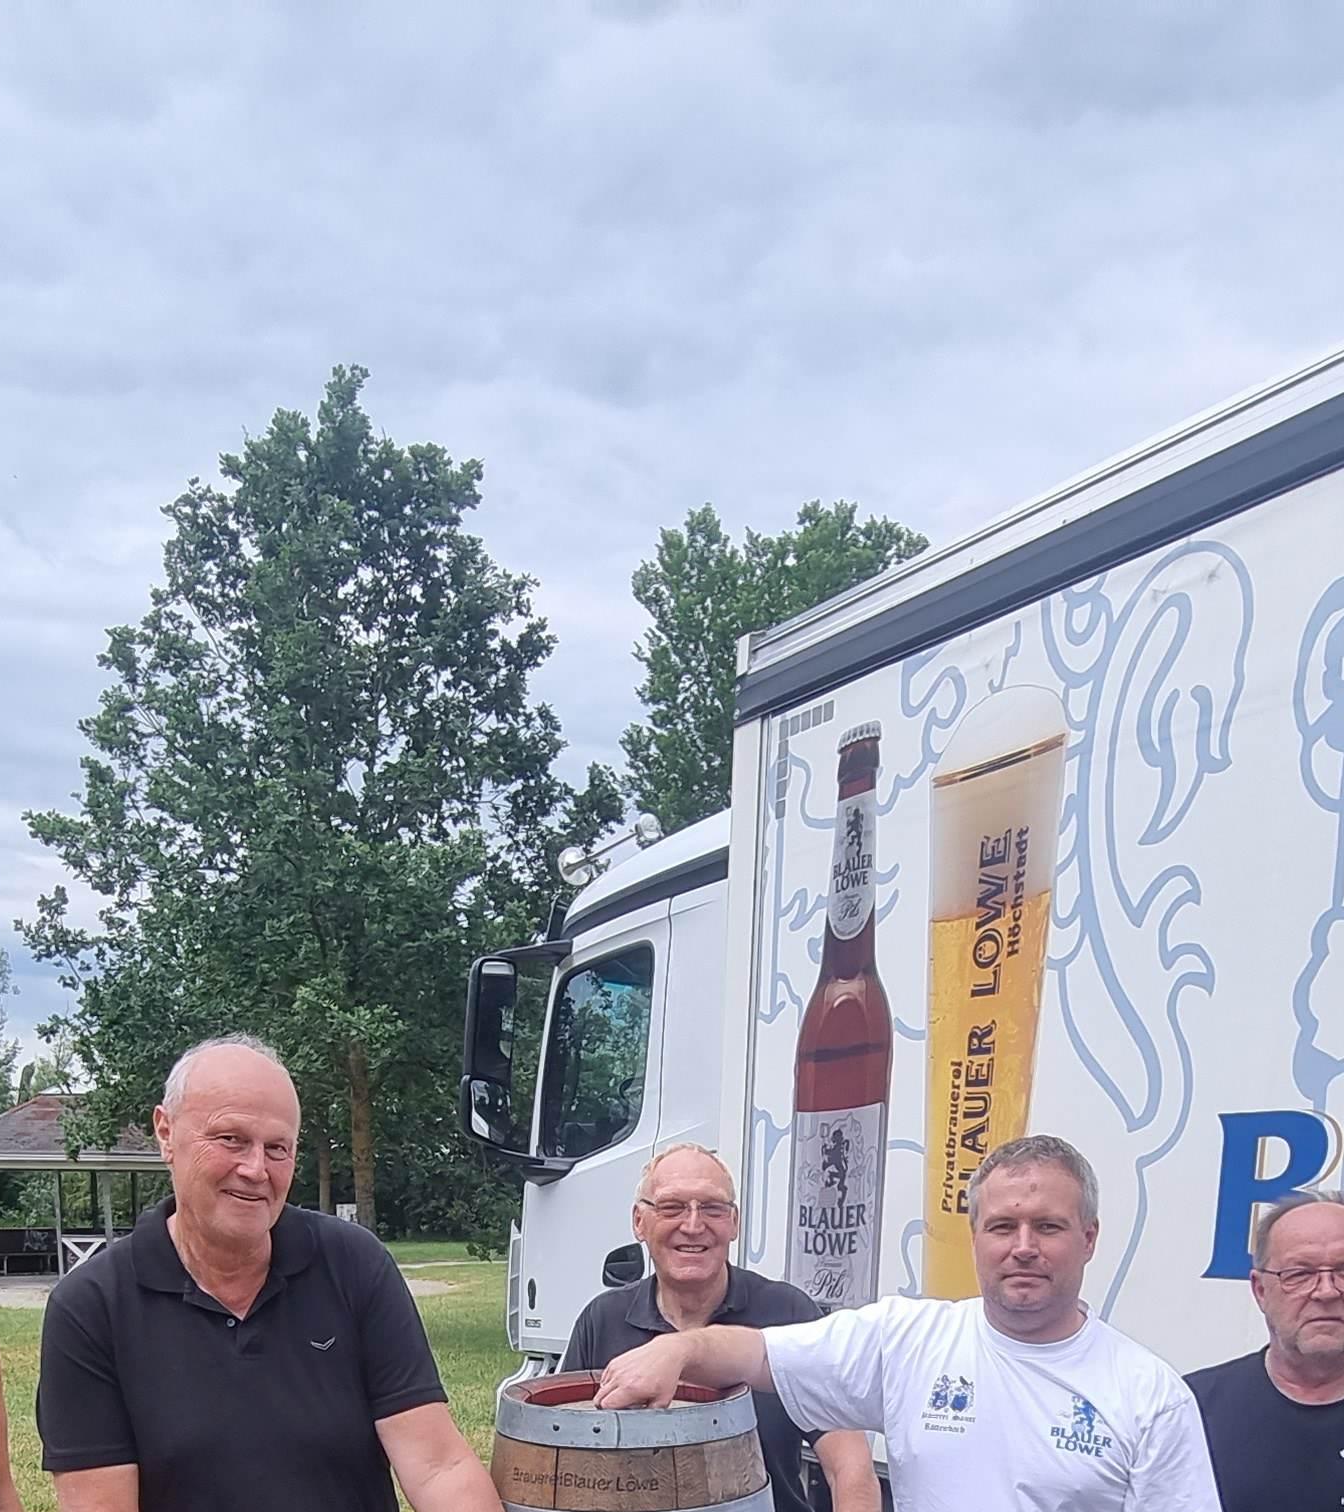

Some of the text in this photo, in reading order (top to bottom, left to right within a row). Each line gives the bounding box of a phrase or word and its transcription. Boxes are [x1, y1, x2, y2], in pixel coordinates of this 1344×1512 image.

[1007, 825, 1029, 960] Höchstadt
[941, 1059, 963, 1213] Privatbrauerei
[799, 1203, 866, 1229] BLAUER
[804, 1229, 857, 1256] LÖWE
[809, 1268, 847, 1299] Pils
[1050, 1426, 1112, 1449] BLAUER
